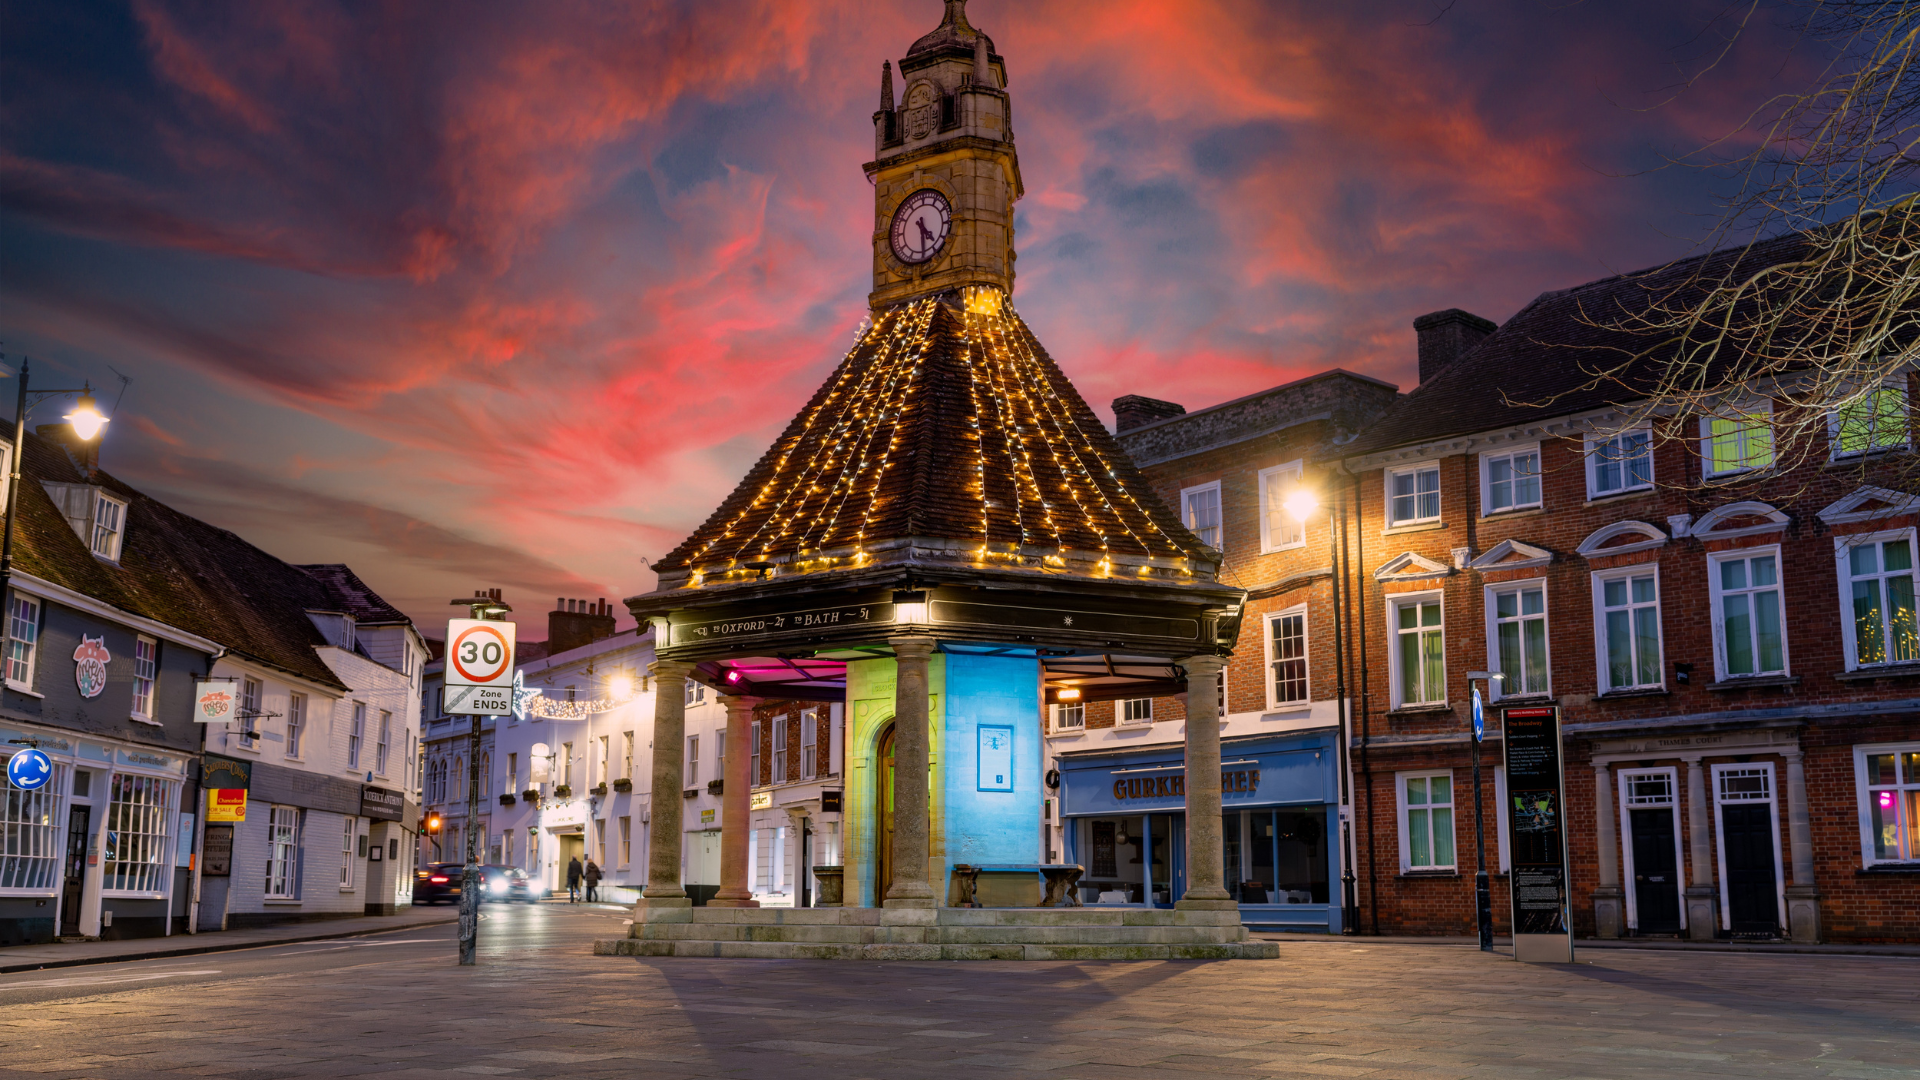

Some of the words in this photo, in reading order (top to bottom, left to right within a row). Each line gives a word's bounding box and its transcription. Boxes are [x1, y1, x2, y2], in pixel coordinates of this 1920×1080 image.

[721, 620, 765, 634] OXFORD
[804, 612, 840, 626] BATH
[460, 641, 502, 665] 30
[480, 689, 502, 698] Zone
[473, 699, 507, 710] ENDS
[1658, 738, 1691, 747] THAMES
[1695, 736, 1723, 744] COURT
[1113, 774, 1186, 800] GURKH
[1221, 769, 1261, 793] HEF
[364, 790, 384, 803] RODERICK
[384, 795, 403, 807] ANTHONY
